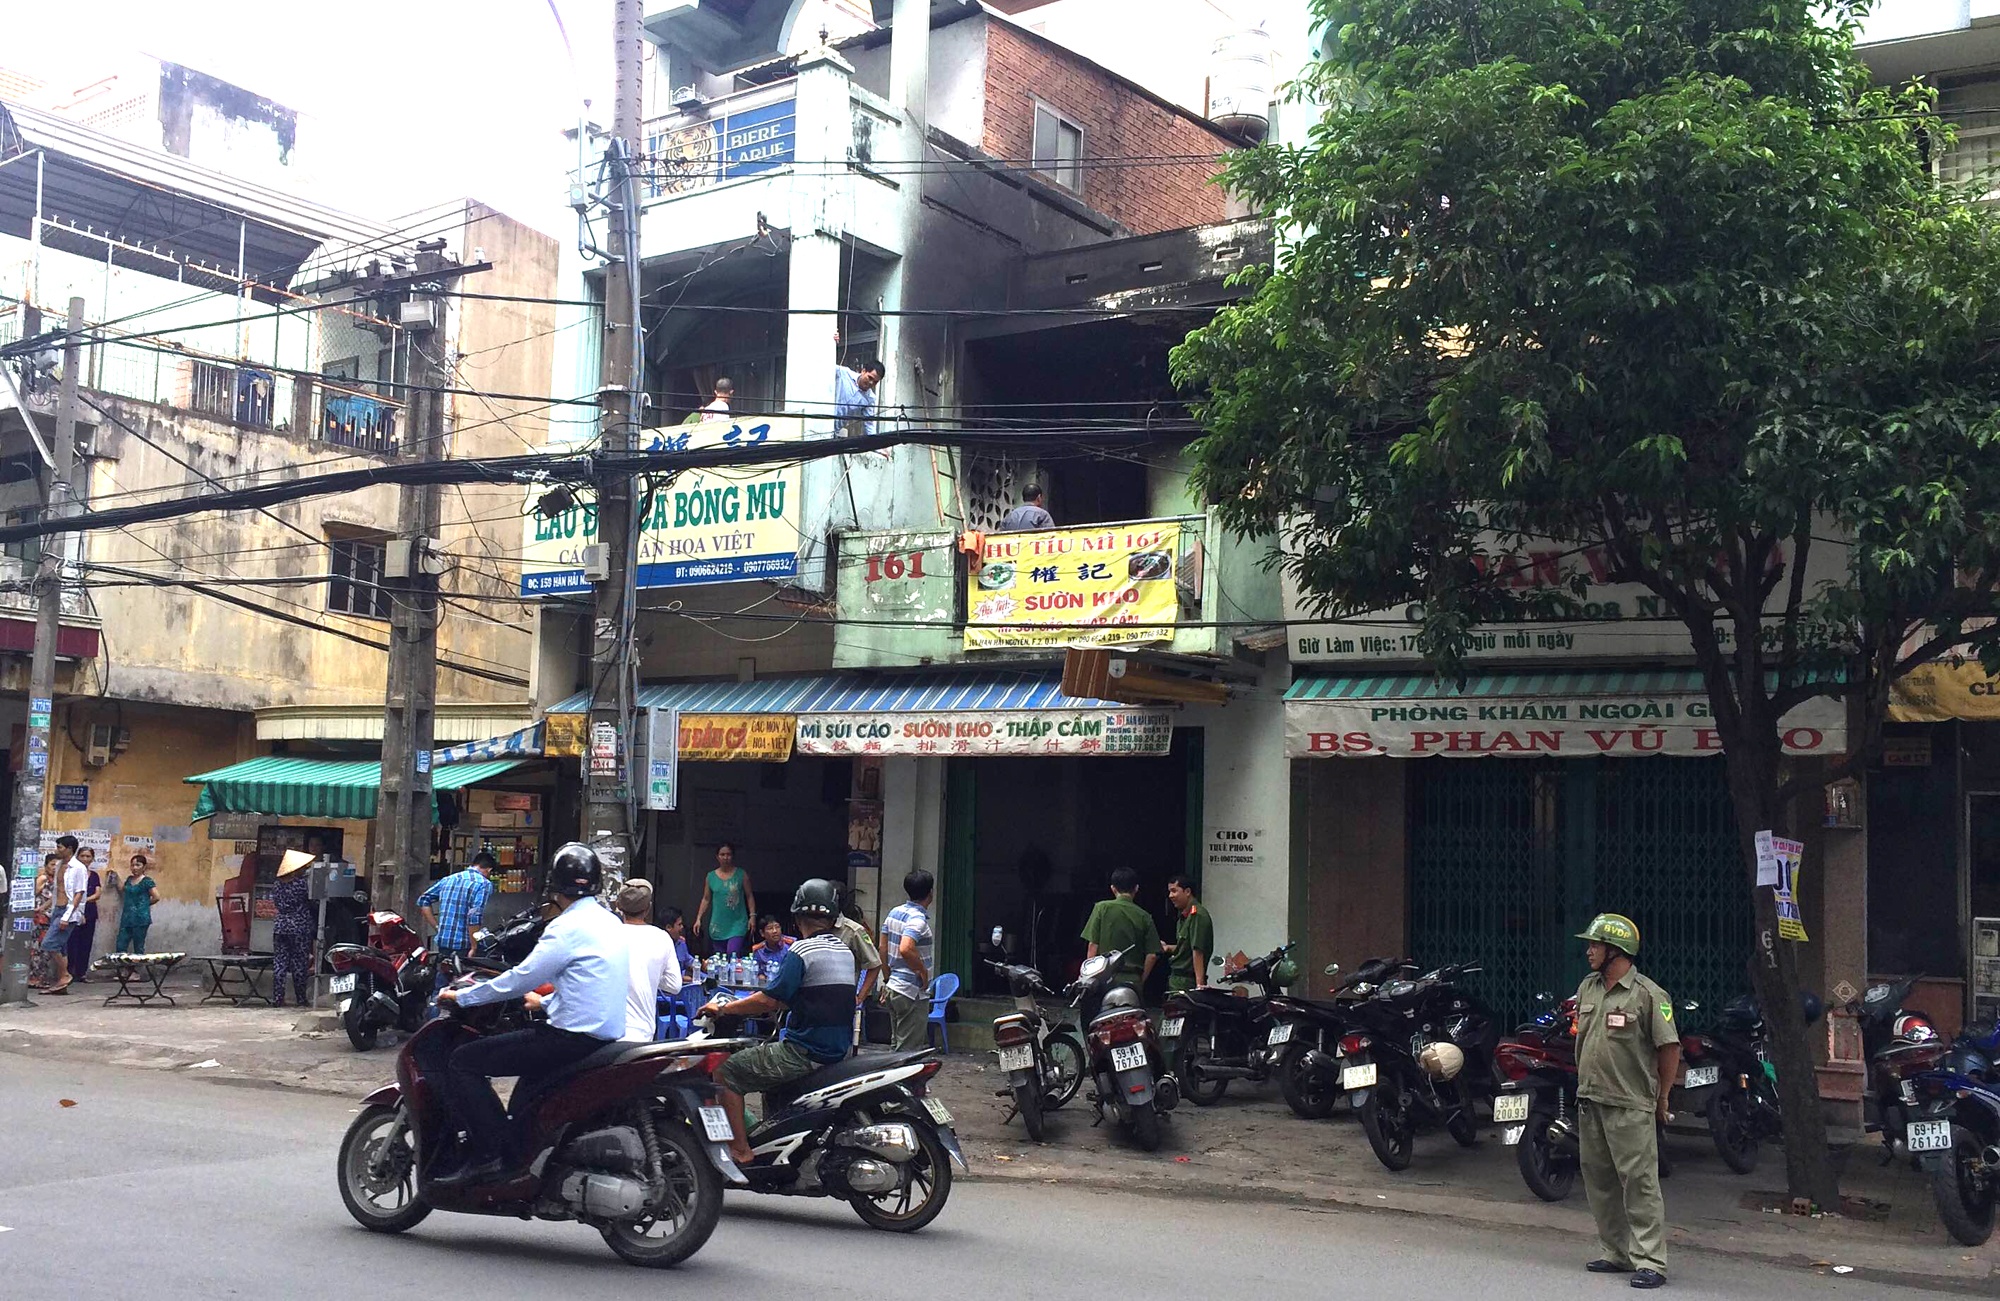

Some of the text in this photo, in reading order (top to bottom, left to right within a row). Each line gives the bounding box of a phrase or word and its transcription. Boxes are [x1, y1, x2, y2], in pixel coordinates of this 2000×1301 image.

[731, 124, 780, 148] BIERE
[674, 475, 739, 527] BỐNG
[712, 531, 755, 554] VIỆT
[1083, 531, 1114, 551] MÌ
[1126, 531, 1162, 549] 161
[864, 551, 926, 582] 161
[1025, 588, 1140, 611] SƯỜN KHO
[1108, 633, 1120, 642] 219
[1126, 631, 1139, 640] 090
[1299, 637, 1320, 654] Giờ
[1326, 636, 1354, 653] Làm
[1360, 636, 1397, 656] Việc:
[1503, 630, 1530, 648] mỗi
[1537, 630, 1574, 650] ngày
[1371, 703, 1467, 722] PHÒNG
[1479, 700, 1567, 720] KHÁM
[1579, 699, 1674, 719] NGOÀI
[801, 720, 820, 739] MÌ
[903, 717, 952, 738] SƯỜN
[955, 720, 993, 737] KHO
[1006, 715, 1054, 742] THẬP
[1057, 712, 1102, 737] CẨM
[1307, 731, 1388, 752] BS.
[1410, 730, 1565, 752] PHAN
[1584, 724, 1667, 751] VŨ
[1216, 831, 1248, 840] CHO
[1229, 842, 1253, 852] PHÒNG
[1116, 1047, 1140, 1060] 59-M1
[1496, 1108, 1527, 1119] 200.93
[1500, 1098, 1523, 1108] 59-P1
[1914, 1123, 1942, 1135] 69-F1
[1911, 1135, 1949, 1149] 261.20
